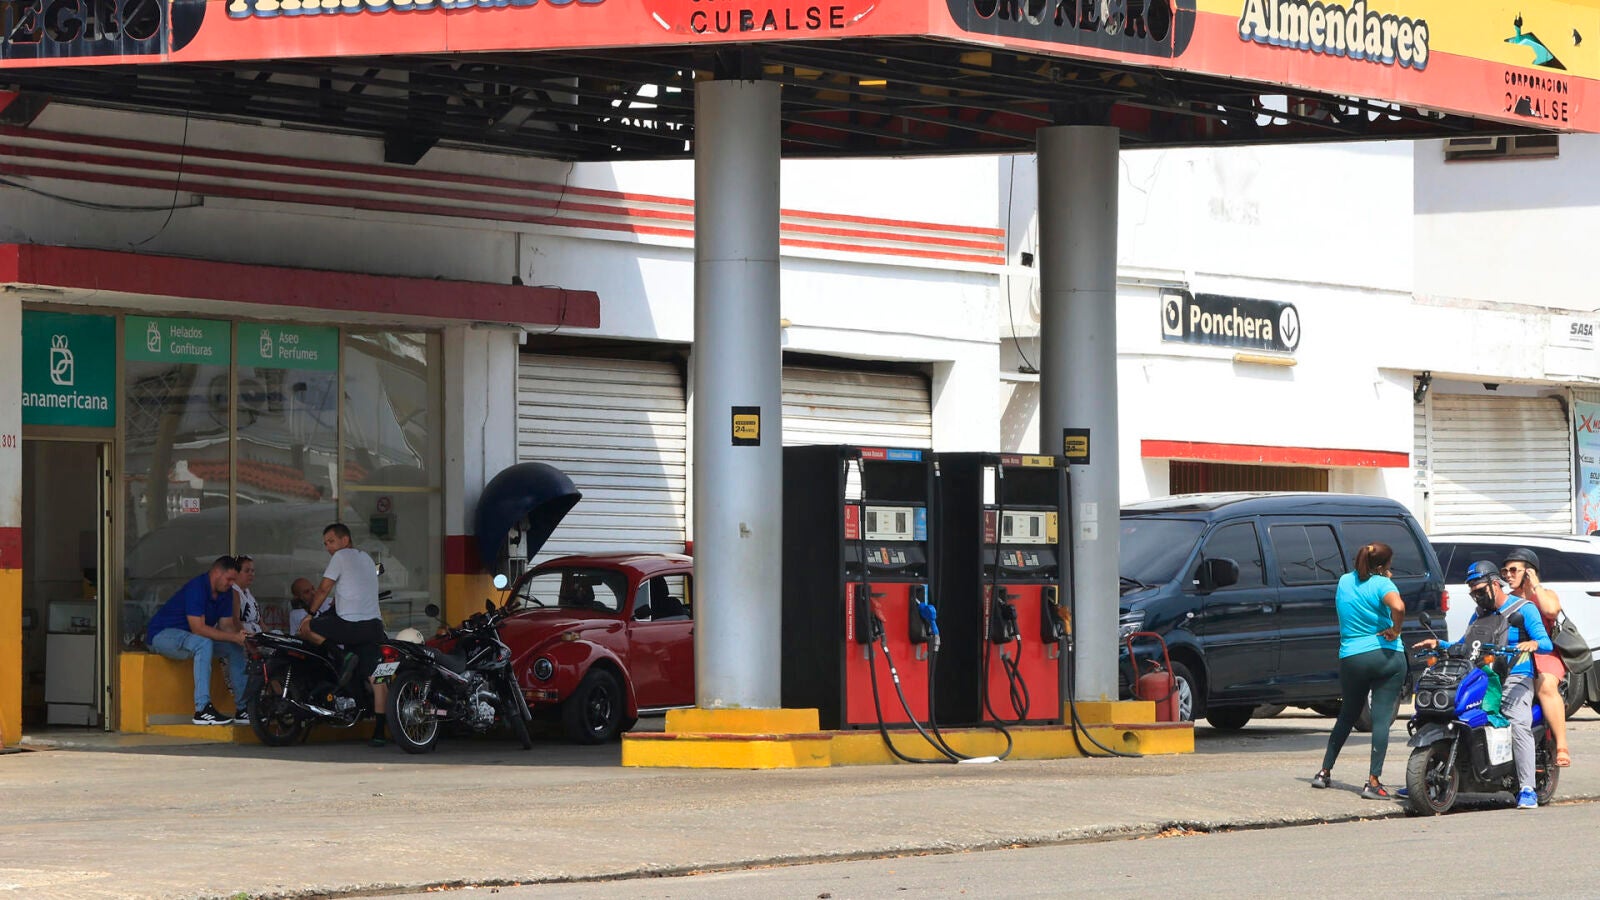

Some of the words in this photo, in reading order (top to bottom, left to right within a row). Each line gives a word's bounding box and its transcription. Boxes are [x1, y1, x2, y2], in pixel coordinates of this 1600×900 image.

[690, 6, 844, 34] CUBALSE
[1240, 0, 1428, 68] Almendares
[1504, 71, 1568, 94] CORPORACION
[1190, 304, 1273, 341] Ponchera
[1570, 322, 1593, 336] SASA
[170, 325, 203, 339] Helados
[278, 331, 299, 345] Aseo
[170, 341, 213, 356] Confituras
[278, 346, 318, 361] Perfumes
[22, 390, 108, 410] anamericana
[2, 434, 16, 448] 301
